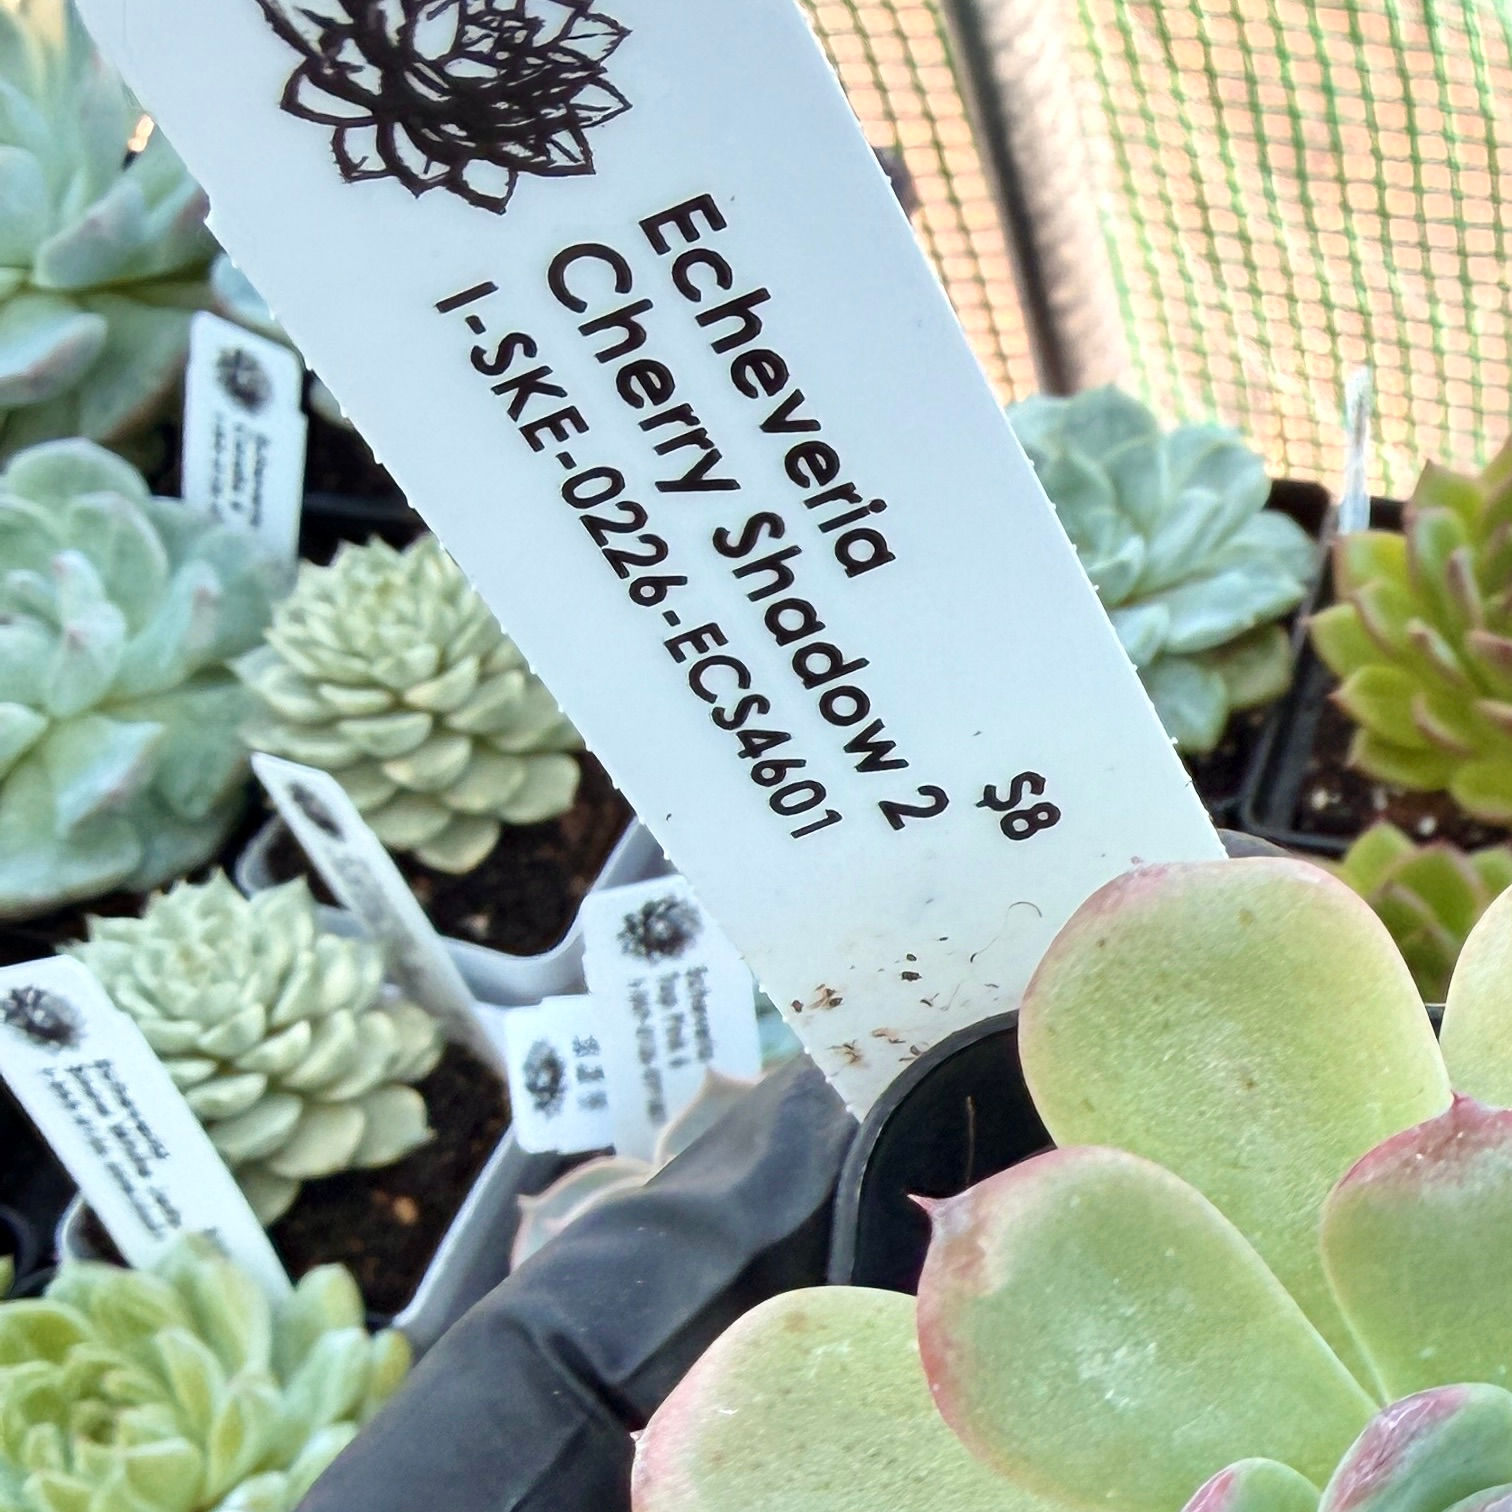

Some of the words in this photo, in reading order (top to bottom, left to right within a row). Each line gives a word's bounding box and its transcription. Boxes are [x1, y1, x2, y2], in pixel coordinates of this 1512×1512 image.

[547, 242, 742, 493] Cherry
[711, 511, 910, 773] Shadow
[877, 784, 950, 831] 2
[638, 193, 897, 579] Echeveria
[975, 770, 1062, 841] $8
